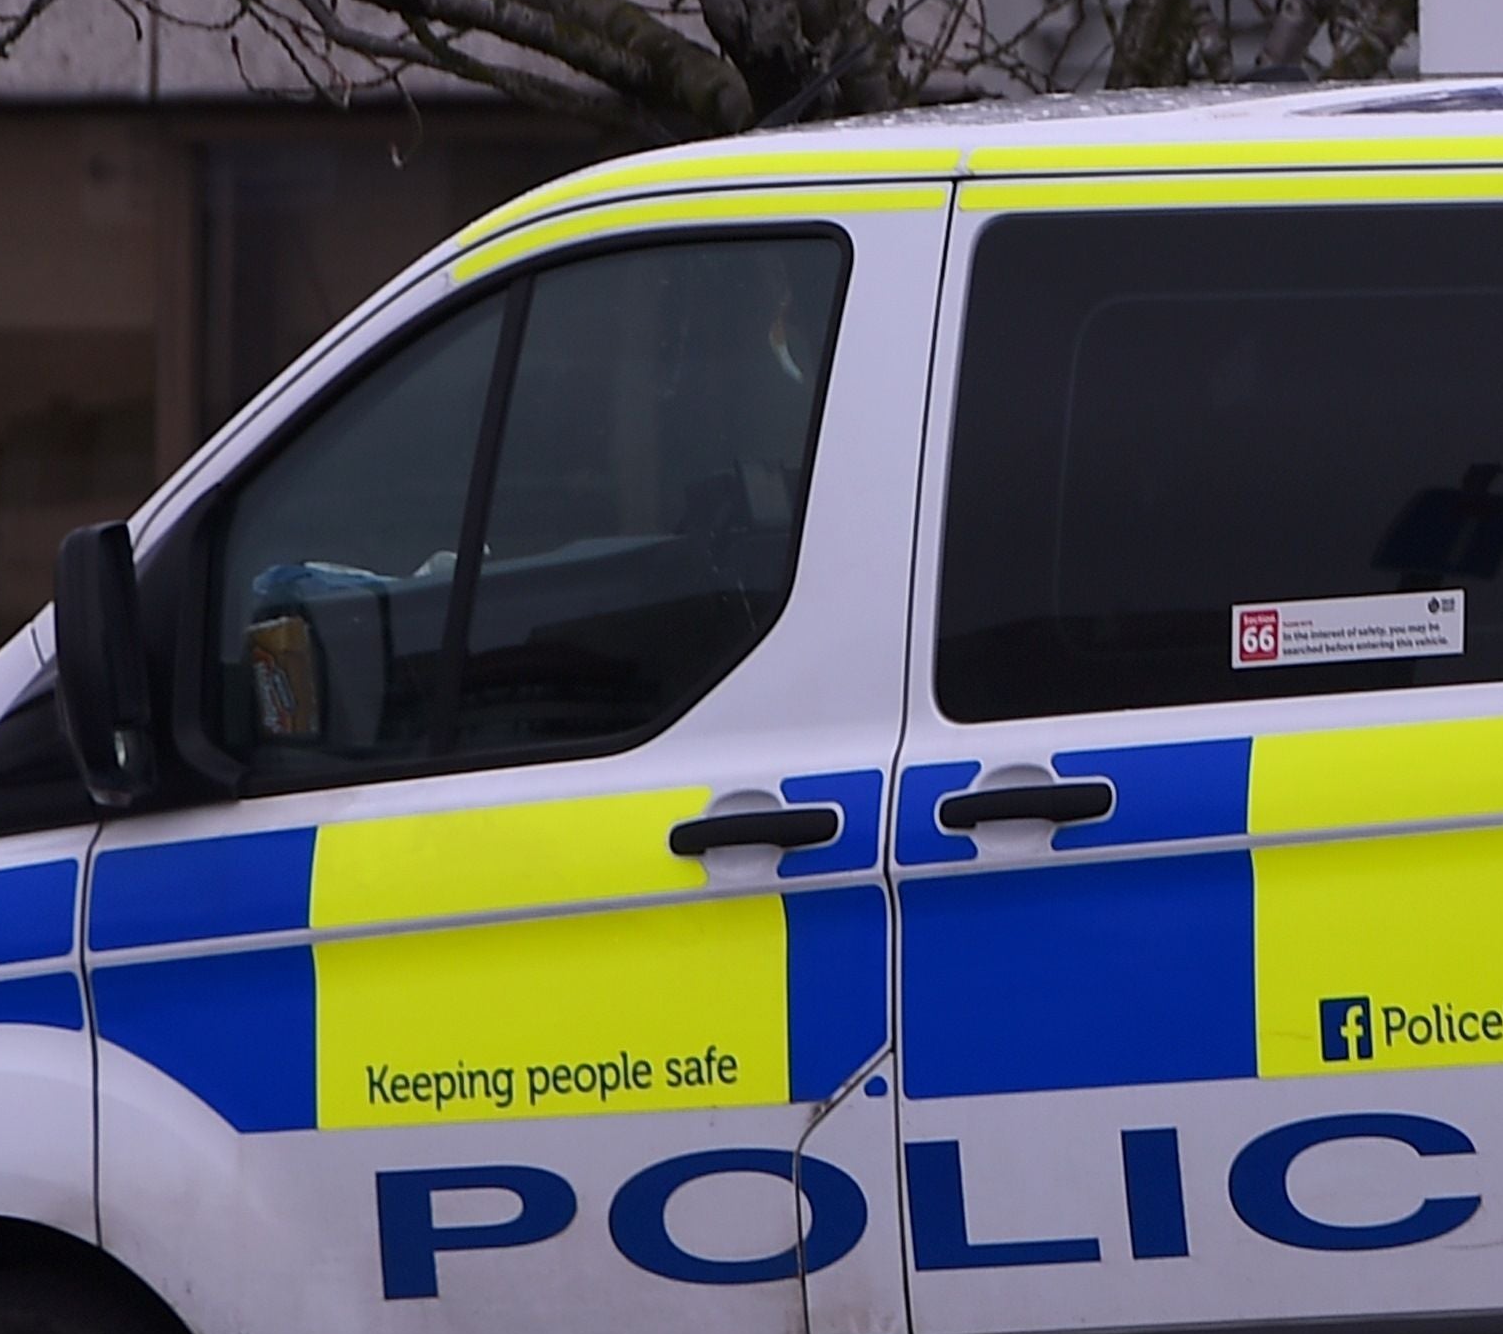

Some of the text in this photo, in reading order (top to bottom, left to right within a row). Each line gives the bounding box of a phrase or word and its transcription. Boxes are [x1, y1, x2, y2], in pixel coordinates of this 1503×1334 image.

[1242, 624, 1276, 654] 66
[364, 1044, 739, 1112] Keeping people safe
